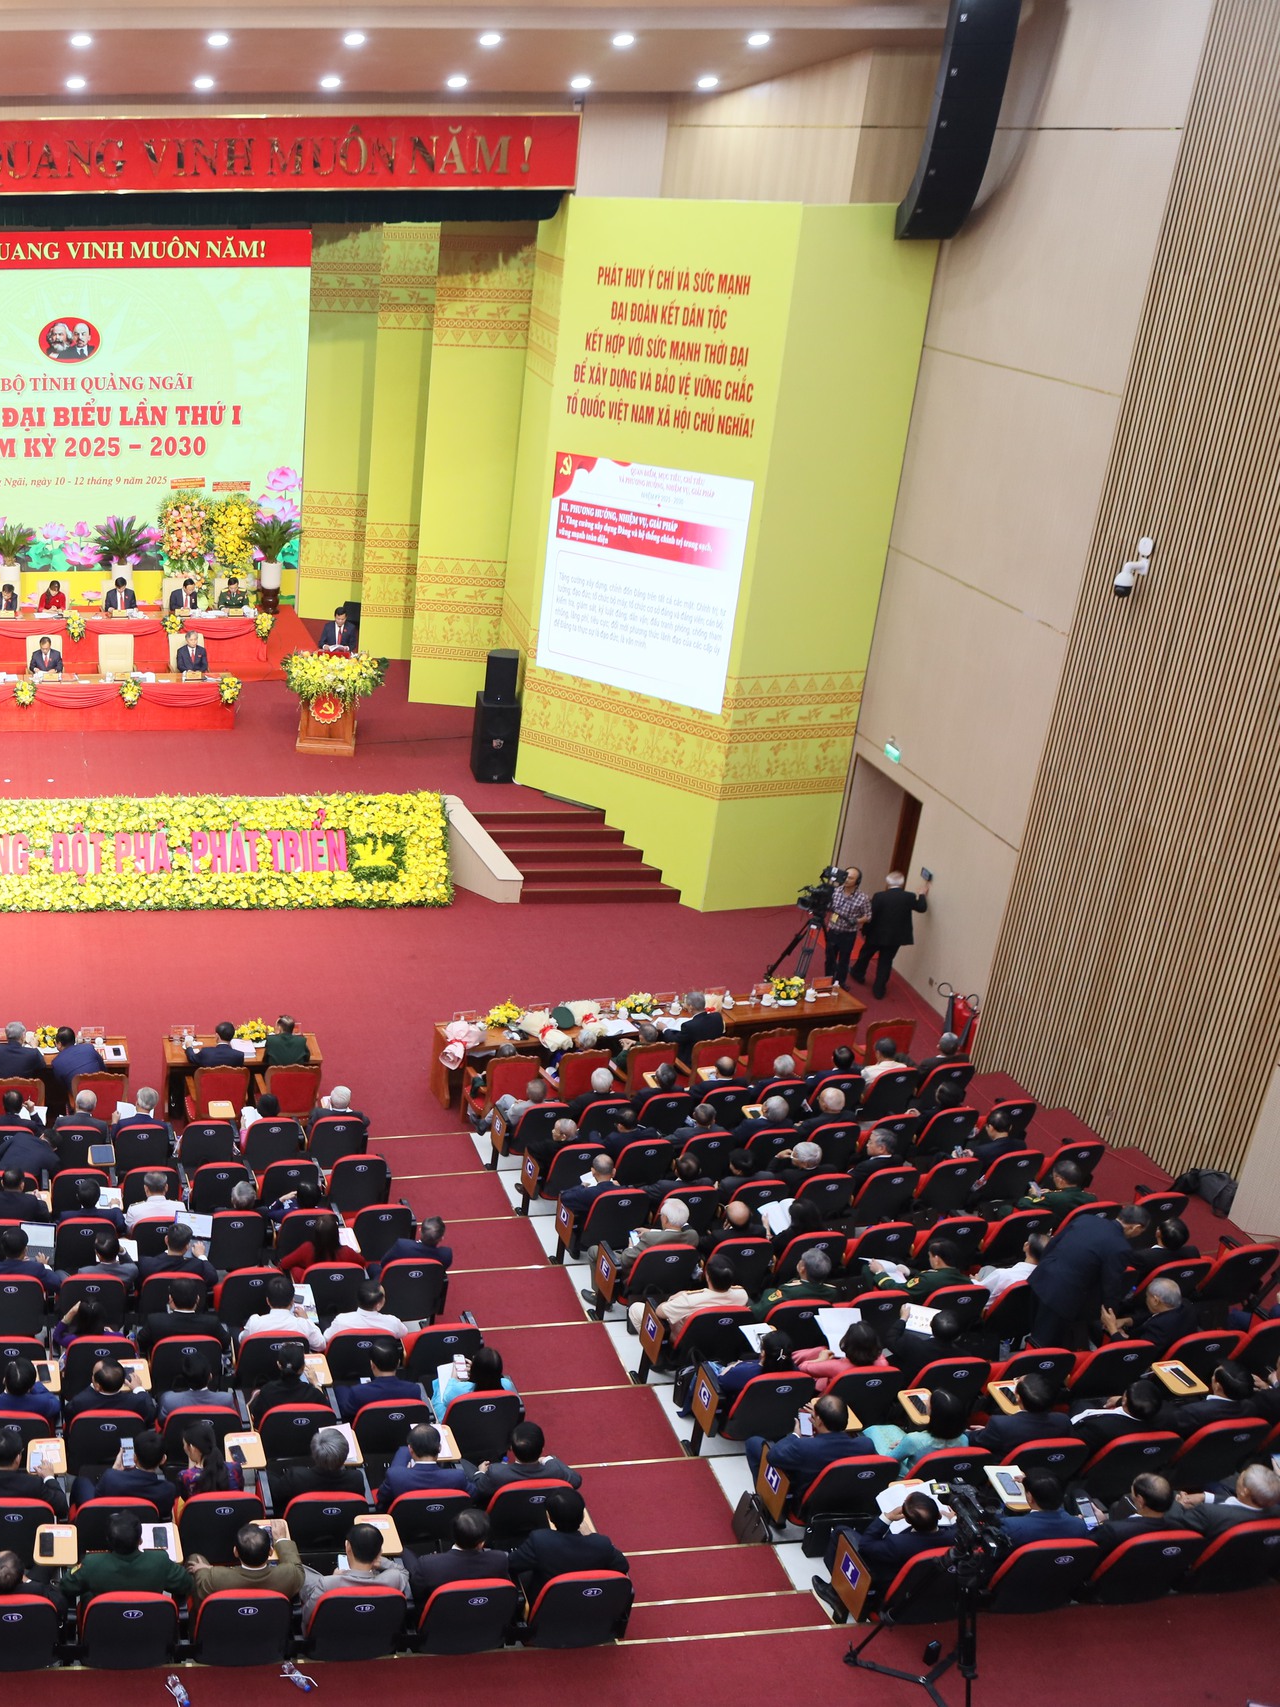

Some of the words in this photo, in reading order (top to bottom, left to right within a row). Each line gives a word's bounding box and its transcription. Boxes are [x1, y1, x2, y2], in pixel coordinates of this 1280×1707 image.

[143, 137, 255, 178] VINH
[267, 124, 398, 177] MUÔN
[409, 124, 511, 176] NĂM
[66, 241, 123, 259] VINH
[130, 236, 200, 259] MUÔN
[206, 235, 267, 258] NĂM!
[597, 263, 623, 286] PHÁT
[625, 268, 645, 288] HUY
[648, 265, 654, 289] Ý
[657, 267, 674, 290] CHÍ
[678, 267, 690, 291] VÀ
[693, 268, 715, 293] SỨC
[717, 274, 751, 299] MẠNH
[611, 301, 628, 325] ĐẠI
[630, 300, 658, 323] ĐOÀN
[661, 299, 680, 325] KẾT
[682, 302, 704, 327] DÂN
[708, 305, 727, 334] TỘC
[585, 327, 603, 352] KẾT
[605, 333, 625, 359] HỢP
[628, 333, 644, 356] VỚI
[647, 335, 667, 359] SỨC
[669, 341, 701, 365] MẠNH
[704, 339, 728, 365] THỜI
[730, 347, 749, 371] ĐẠI
[0, 374, 25, 395] BỘ
[29, 375, 75, 392] TỈNH
[81, 374, 145, 393] QUẢNG
[148, 373, 193, 391] NGÃI
[574, 357, 588, 383] ĐỂ
[589, 363, 608, 385] XÂY
[610, 368, 637, 392] DỰNG
[640, 368, 652, 391] VÀ
[655, 366, 675, 394] BẢO
[679, 372, 691, 400] VỆ
[694, 374, 722, 400] VỮNG
[725, 374, 754, 403] CHẮC
[2, 406, 45, 432] ĐẠI
[53, 398, 111, 427] BIỂU
[119, 398, 168, 426] LẦN
[176, 401, 227, 426] THỨ
[231, 405, 241, 424] I
[567, 389, 579, 414] TỔ
[580, 393, 605, 419] QUỐC
[609, 399, 629, 425] VIỆT
[631, 404, 655, 425] NAM
[657, 404, 670, 427] XÃ
[673, 408, 691, 434] HỘI
[694, 407, 715, 433] CHỦ
[717, 413, 755, 439] NGHĨA!
[24, 433, 57, 457] KỲ
[64, 436, 121, 457] 2025
[150, 435, 206, 456] 2030
[4, 477, 28, 487] Ngãi,
[31, 477, 52, 488] ngày
[54, 476, 66, 486] 10
[75, 476, 85, 486] 12
[86, 476, 112, 488] tháng
[115, 476, 121, 485] 9
[123, 478, 143, 486] năm
[146, 475, 168, 485] 2025
[52, 823, 107, 884] ĐỘT
[115, 821, 172, 873] PHÁ
[191, 821, 257, 873] PHÁT
[267, 808, 348, 872] TRIỂN
